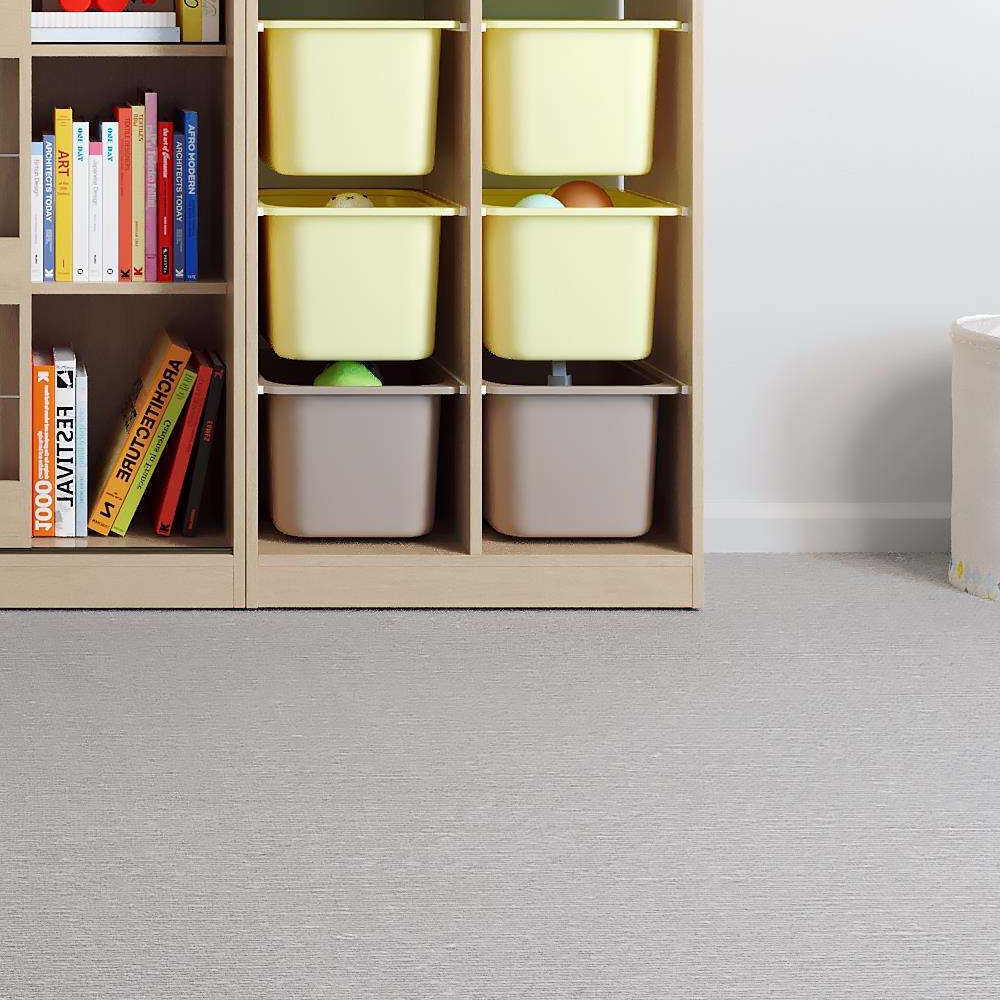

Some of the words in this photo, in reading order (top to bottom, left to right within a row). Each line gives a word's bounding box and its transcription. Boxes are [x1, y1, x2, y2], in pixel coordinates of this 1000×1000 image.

[188, 125, 196, 151] AFRO
[45, 142, 53, 192] ARCHITECTS
[58, 150, 70, 177] ART
[188, 152, 196, 195] MODERN
[45, 194, 53, 222] TODAY
